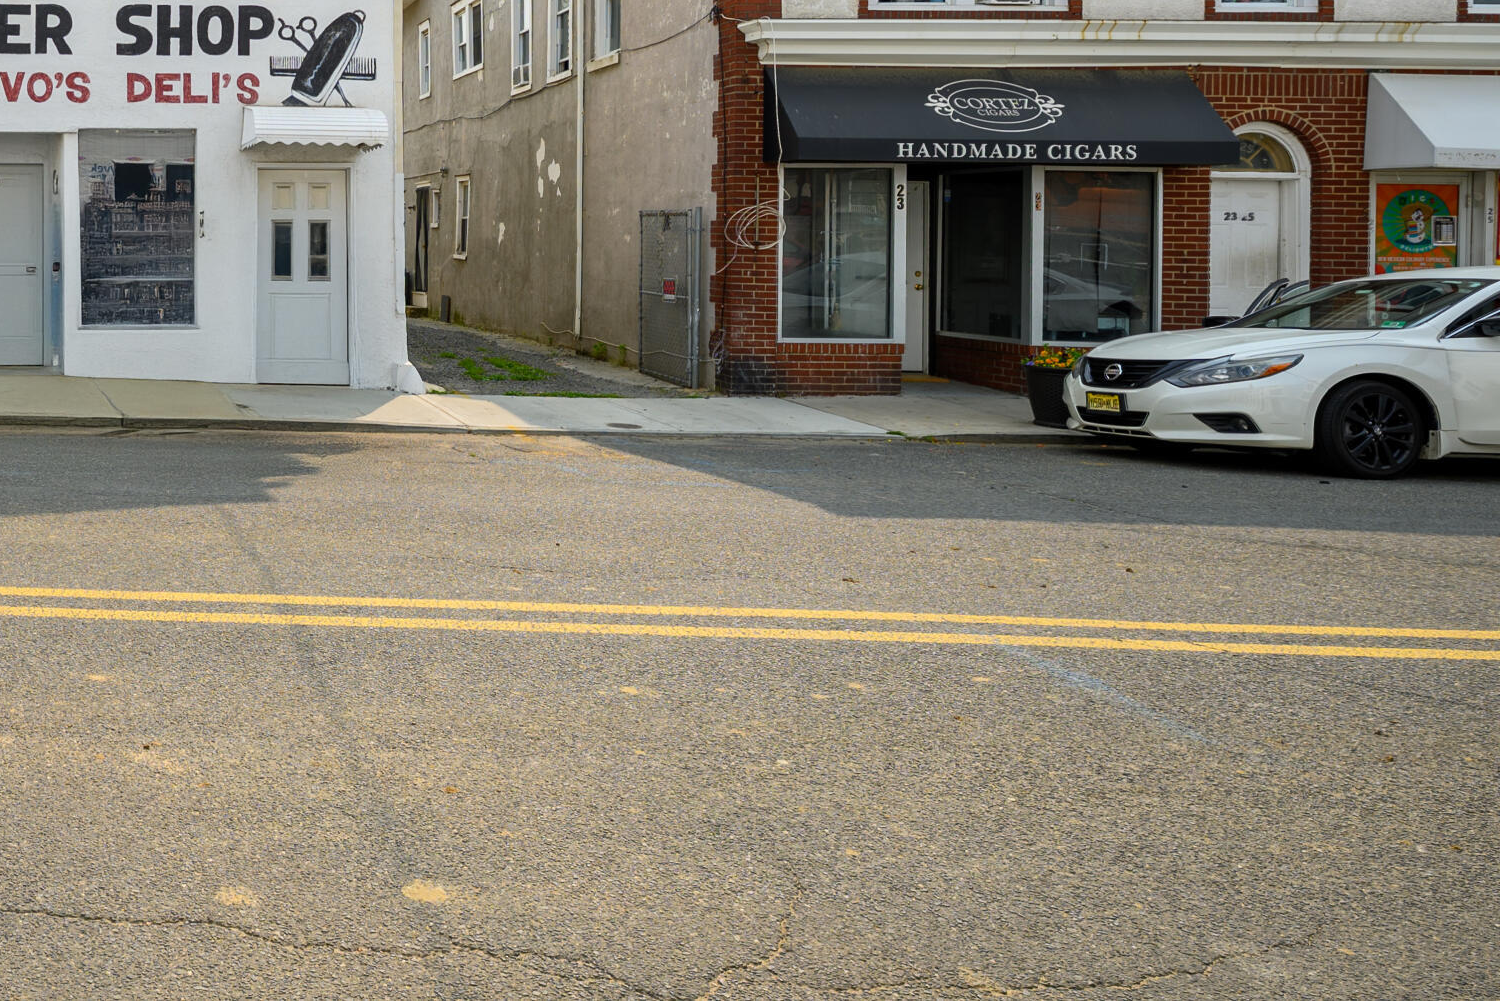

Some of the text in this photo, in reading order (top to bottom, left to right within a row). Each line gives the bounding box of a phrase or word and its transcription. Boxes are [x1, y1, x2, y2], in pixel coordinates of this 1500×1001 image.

[116, 4, 274, 56] SHOP
[127, 73, 260, 104] DELI'S
[953, 98, 1036, 111] CORTEZ
[977, 109, 1020, 117] CIGARS
[896, 142, 1137, 161] HANDMADE CIGARS
[896, 184, 905, 210] 23
[1223, 212, 1238, 221] 23
